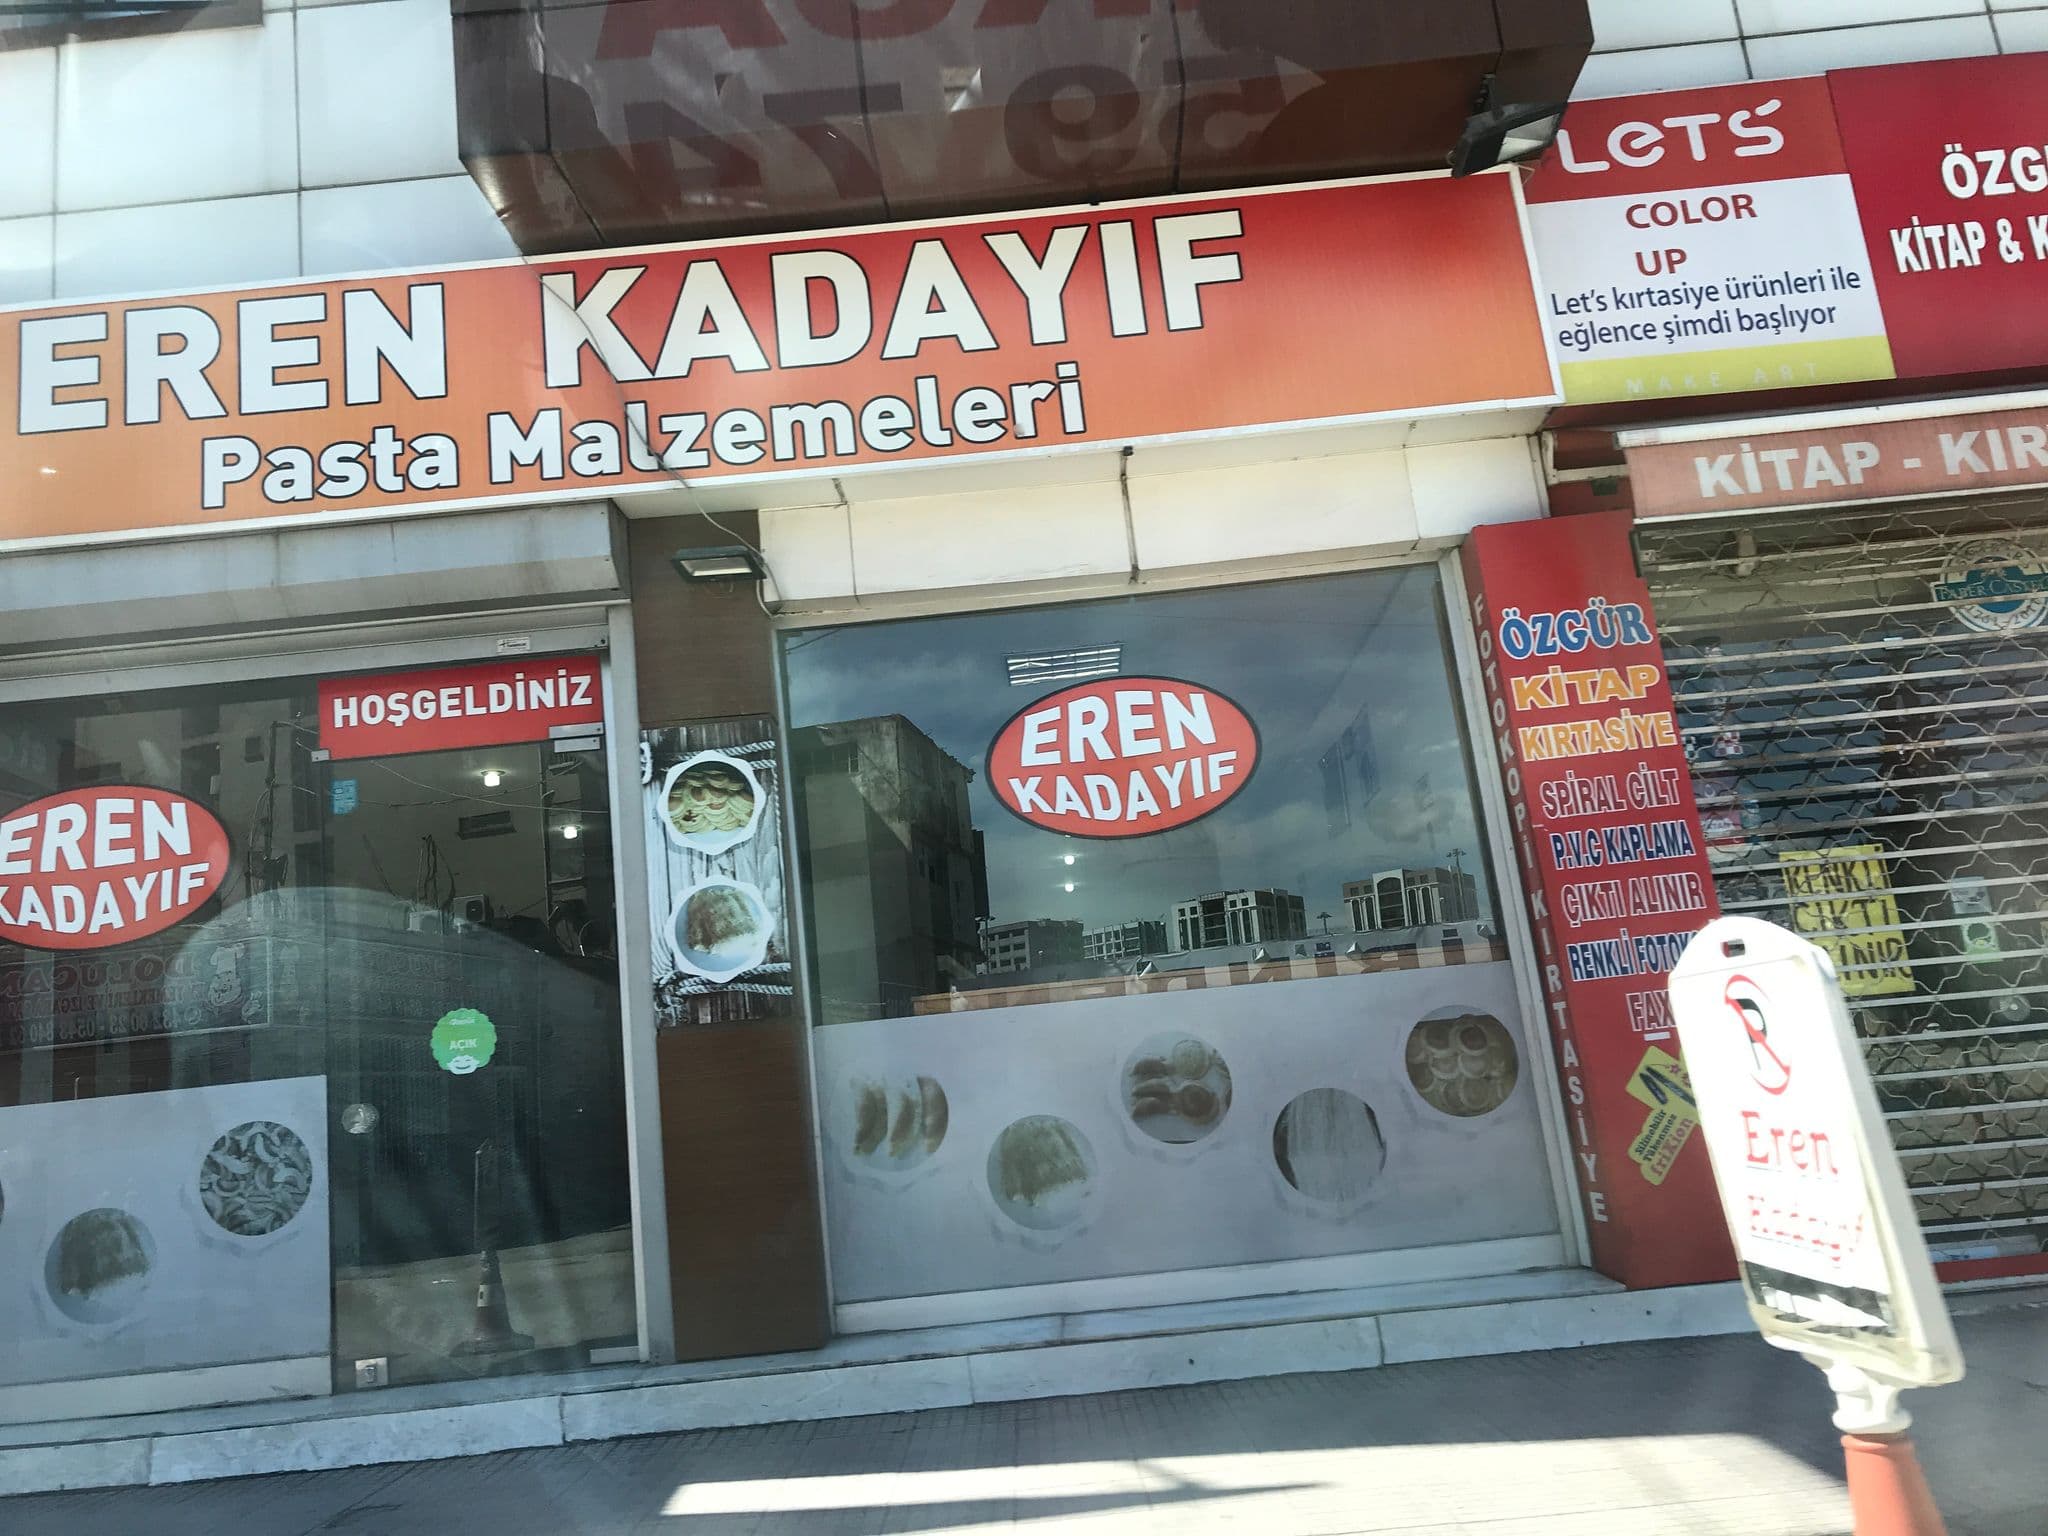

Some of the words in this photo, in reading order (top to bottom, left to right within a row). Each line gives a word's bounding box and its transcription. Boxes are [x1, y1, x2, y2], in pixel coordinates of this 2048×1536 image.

[1941, 143, 2048, 199] ÖZG
[1625, 193, 1758, 229] COLOR
[1635, 248, 1687, 277] UP
[1890, 215, 1986, 274] KİTAP
[1996, 218, 2025, 264] &
[1611, 281, 1720, 316] kırtasiye
[1725, 268, 1828, 302] ürünleri
[1829, 265, 1862, 291] ile
[17, 282, 448, 435] EREN
[540, 210, 1243, 389] KADAYIF
[1558, 319, 1658, 352] eğlence
[1663, 309, 1732, 345] şimdi
[1736, 303, 1837, 335] başlıyor
[1626, 371, 1723, 394] MAKE
[1753, 362, 1817, 384] ART
[202, 426, 459, 510] Pasta
[488, 361, 1087, 484] Malzemeleri
[1695, 442, 1881, 498] KİTAP
[1938, 425, 2048, 476] KIR
[1500, 597, 1653, 660] ÖZGÜR
[333, 668, 593, 729] HOŞGELDİNİZ
[1511, 665, 1660, 711] KİTAP
[1020, 690, 1217, 767] EREN
[1519, 708, 1678, 762] KIRTASİYE
[1007, 750, 1237, 822] KADAYIF
[1540, 770, 1627, 819] SPİRAL
[0, 798, 192, 875] EREN
[1604, 820, 1696, 864] KAPLAMA
[1473, 594, 1534, 869] FOTOKOPİ
[1531, 886, 1609, 1223] KIRTASİYE
[1561, 880, 1627, 928] ÇIKTI
[1629, 872, 1708, 916] ALINIR
[1565, 928, 1636, 982] RENKLİ
[1626, 989, 1677, 1031] FAX
[449, 1038, 478, 1052] AÇIK
[1740, 1110, 1839, 1175] Eren
